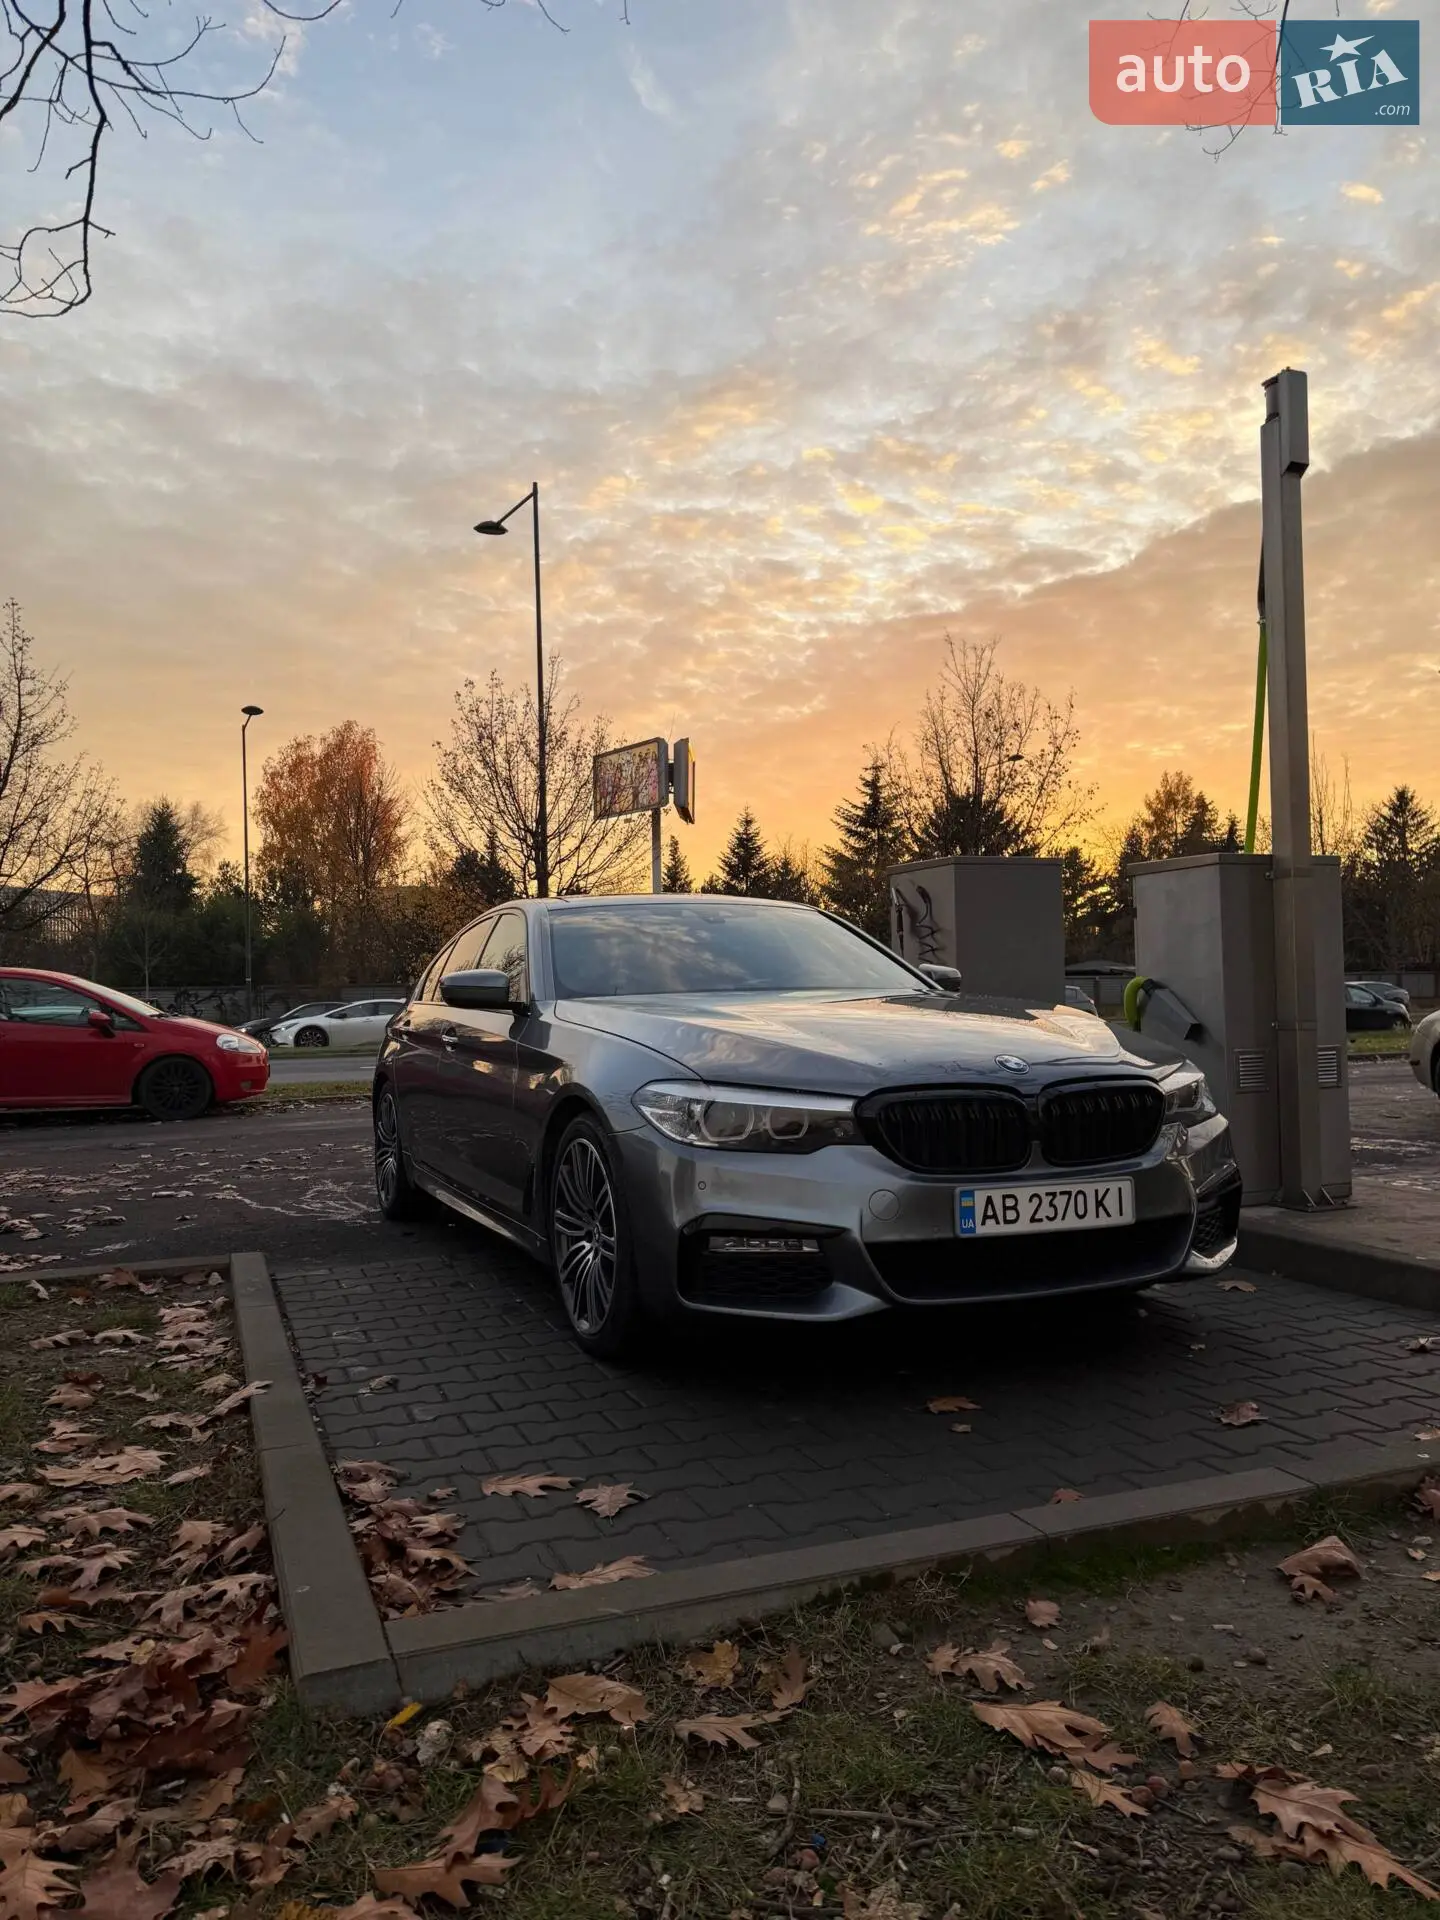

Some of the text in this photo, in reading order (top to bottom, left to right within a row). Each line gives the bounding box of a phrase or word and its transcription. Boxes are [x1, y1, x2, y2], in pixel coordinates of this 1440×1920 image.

[980, 1186, 1124, 1226] AB 2370 KI
[961, 1219, 975, 1229] UA
